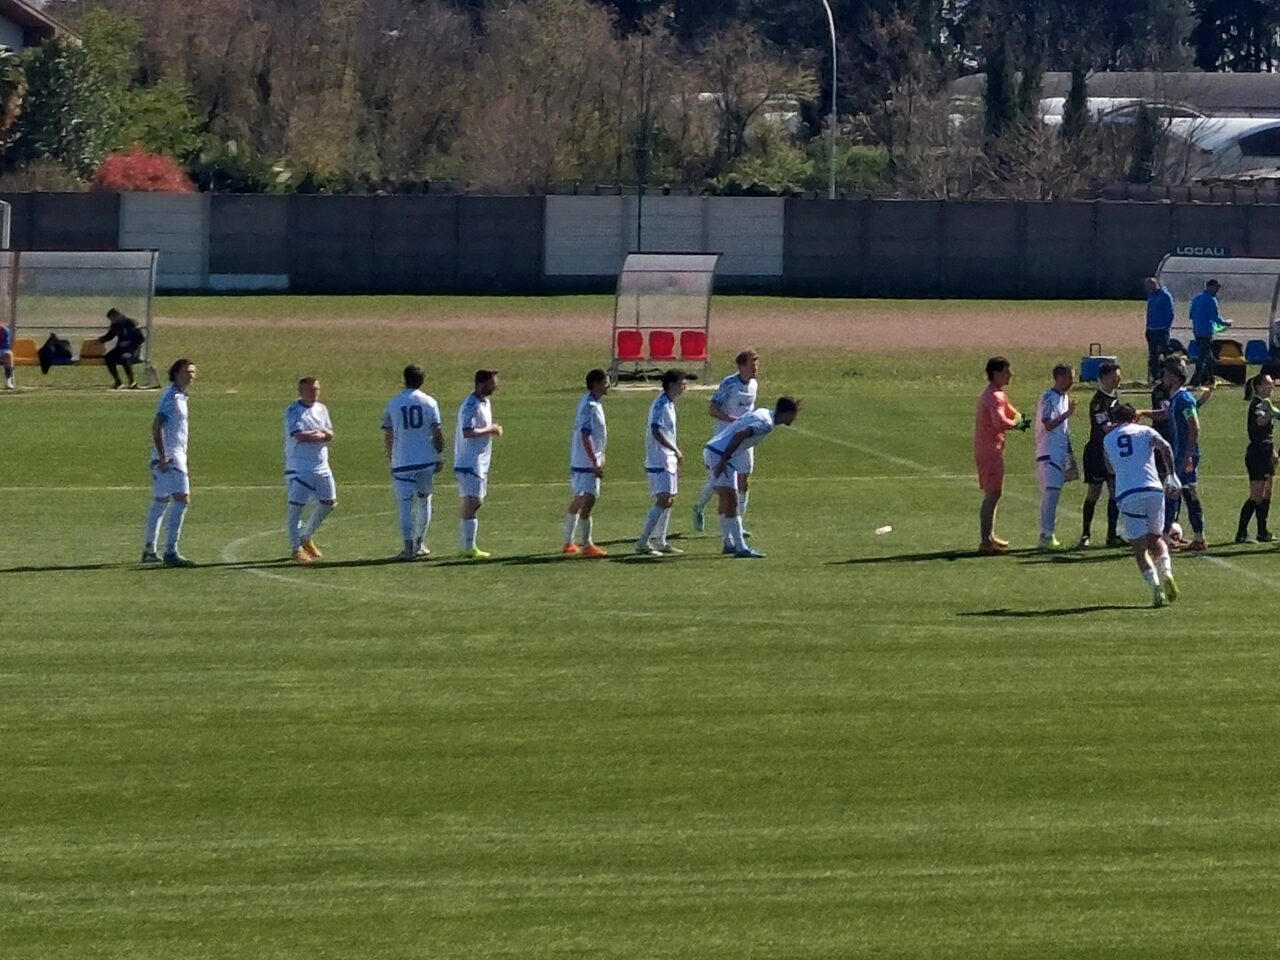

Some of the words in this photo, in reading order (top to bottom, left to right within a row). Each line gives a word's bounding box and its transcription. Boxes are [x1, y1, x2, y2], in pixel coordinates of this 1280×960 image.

[1176, 246, 1225, 256] LOCALI
[400, 405, 424, 430] 10
[1116, 434, 1134, 458] 9
